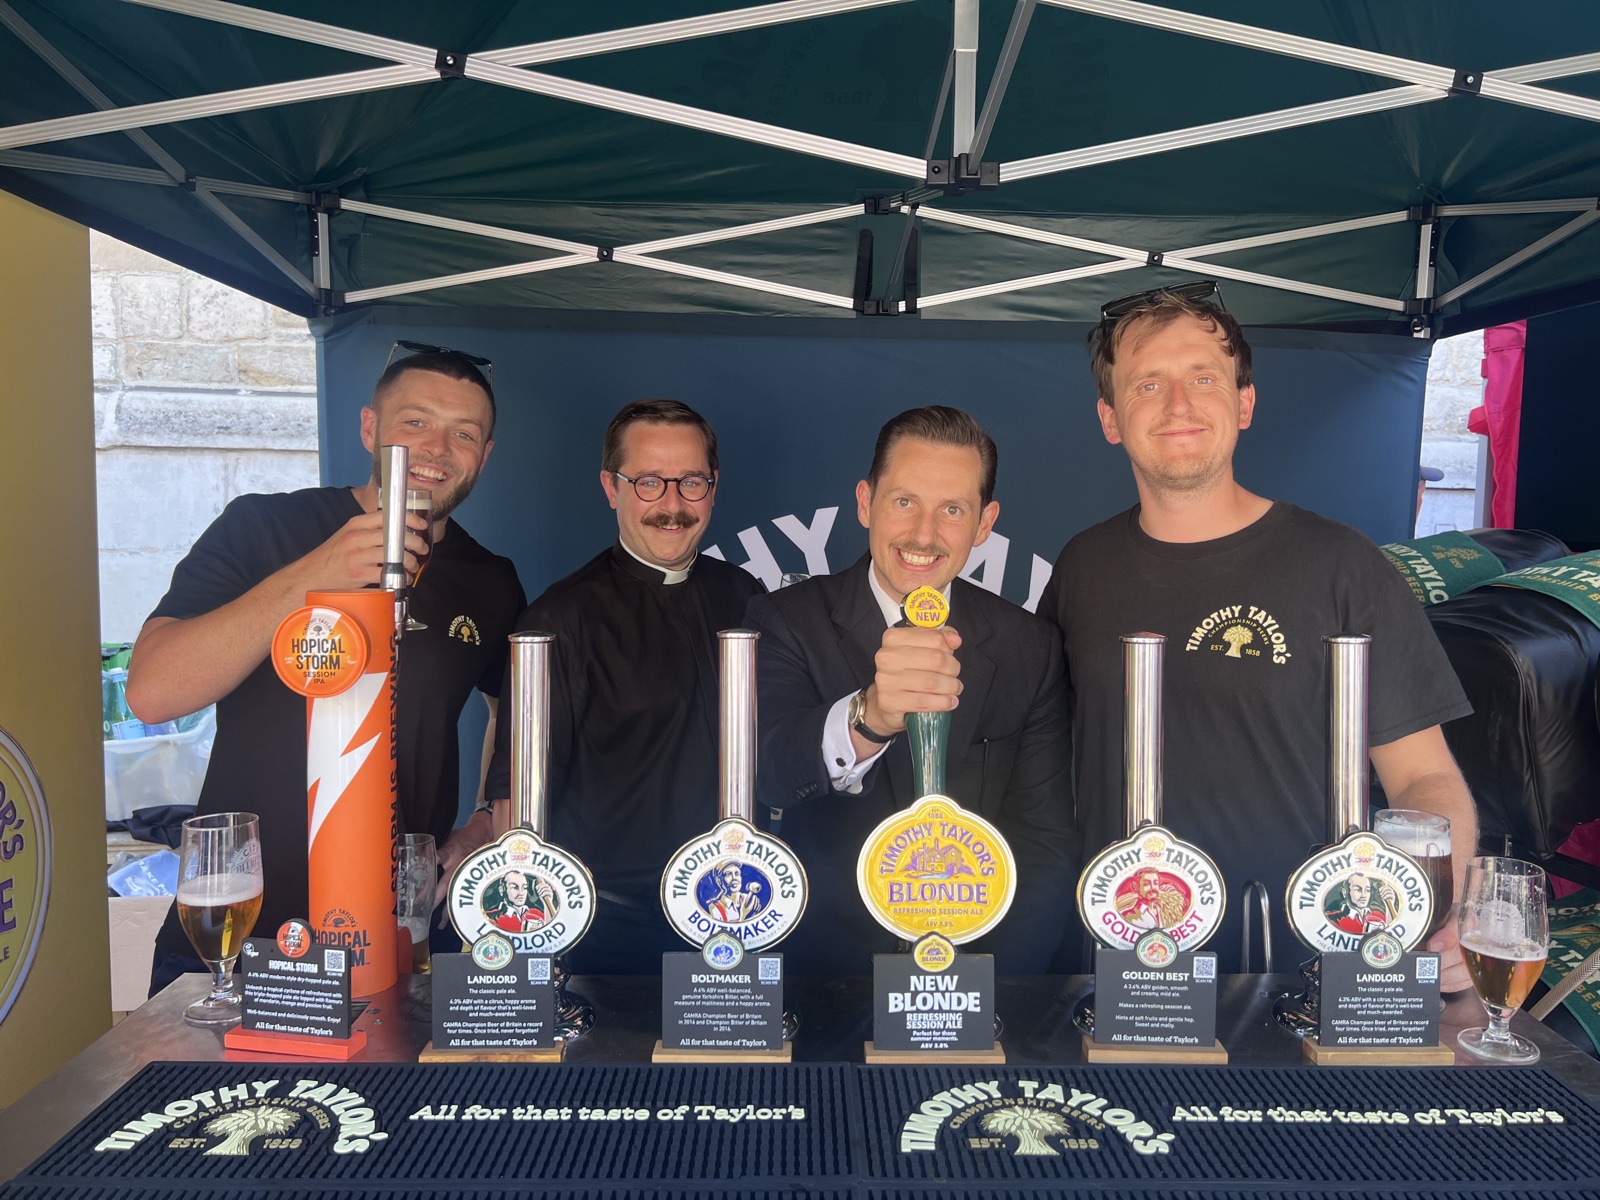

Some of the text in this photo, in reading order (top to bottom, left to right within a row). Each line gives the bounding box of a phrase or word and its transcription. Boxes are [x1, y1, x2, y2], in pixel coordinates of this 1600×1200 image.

[1407, 557, 1449, 604] TAYLO
[916, 611, 940, 621] NEW
[1186, 605, 1291, 664] TIMOTHY TAYLOR'S
[1208, 619, 1269, 645] CHAMPIONSHIP BEERS
[292, 638, 345, 653] HOPICAL
[296, 655, 340, 669] STORM
[880, 822, 996, 877] TIMOTHY TAYLOR'S
[673, 840, 799, 899] TIMOTHY TAYLOR'S
[1091, 848, 1217, 906] TIMOTHY TAYLOR'S
[460, 851, 508, 908] TIMOTHY
[531, 851, 587, 910] TAYLOR'S
[1300, 853, 1425, 912] TIMOTHY TAYLOR'S
[889, 882, 989, 905] BLONDE
[1102, 910, 1204, 944] GOLD BEST
[477, 922, 566, 951] LDLORD
[1317, 923, 1406, 952] LANDD
[1119, 941, 1134, 950] SMOO
[269, 960, 318, 973] HOPICAL STORM
[467, 975, 517, 984] LANDLORD
[691, 974, 751, 984] BOLTMAKER
[910, 975, 959, 991] NEW
[1122, 971, 1190, 981] GOLDEN BEST
[1356, 974, 1405, 982] LANDLORD
[888, 992, 981, 1013] BLONDE
[906, 1013, 962, 1022] REFRESHING
[906, 1020, 962, 1029] SESSION ALE
[310, 1027, 333, 1035] Taylor's
[511, 1038, 537, 1046] Taylor's
[741, 1039, 767, 1047] Taylor's
[1173, 1036, 1199, 1044] Taylor's
[1398, 1036, 1423, 1044] Taylor's
[94, 1079, 389, 1155] TIMOTHY TAYLOR'S
[173, 1098, 331, 1130] CHAMPIONSHIP BEERS
[409, 1104, 805, 1123] All for that taste of Taylor's
[900, 1080, 1175, 1155] TIMOTHY TAYLOR'S
[950, 1098, 1106, 1130] CHAMPIONSHIP BEERS
[1172, 1106, 1564, 1126] All for that taste of Taylor's
[168, 1138, 303, 1149] EST. 1858
[968, 1137, 1099, 1149] EST. 1858
